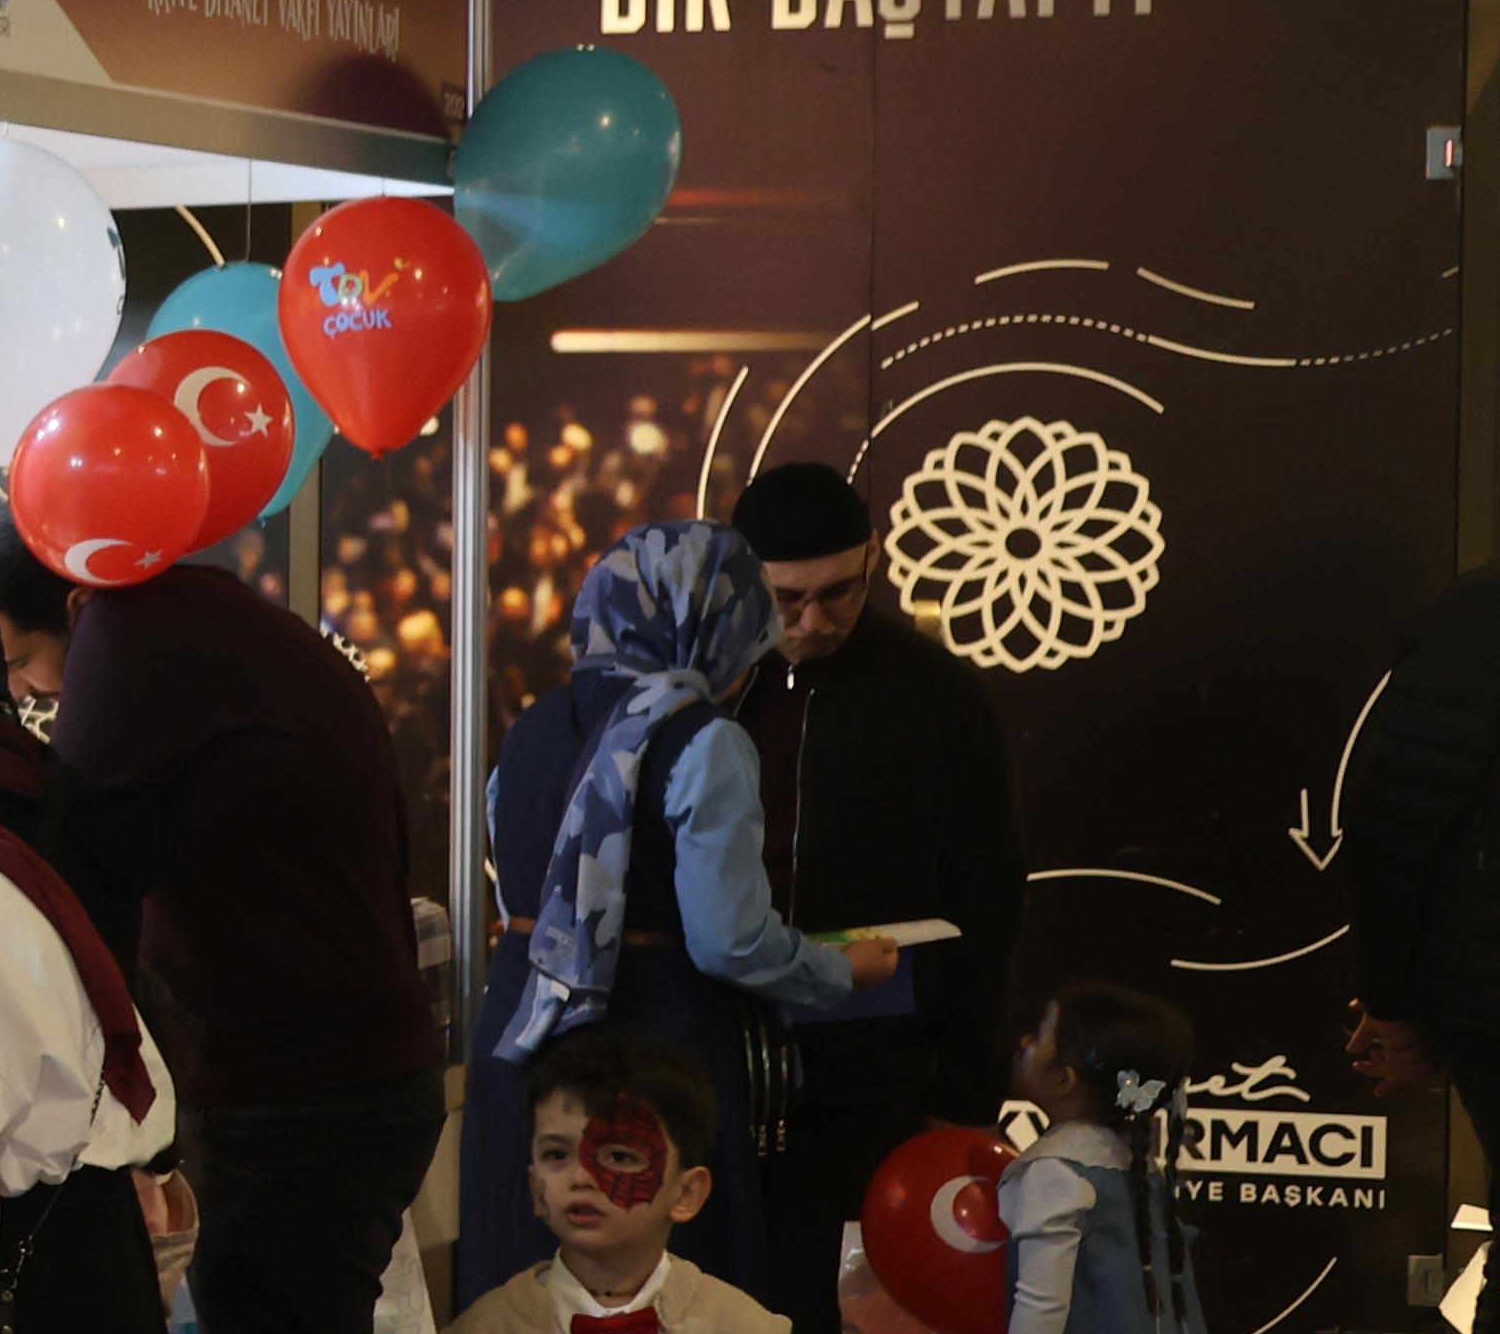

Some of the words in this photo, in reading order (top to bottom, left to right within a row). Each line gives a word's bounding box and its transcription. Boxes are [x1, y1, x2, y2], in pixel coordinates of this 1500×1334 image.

[308, 261, 399, 307] TDV
[323, 308, 394, 340] ÇOCUK
[1239, 1182, 1386, 1210] BAŞKANI
